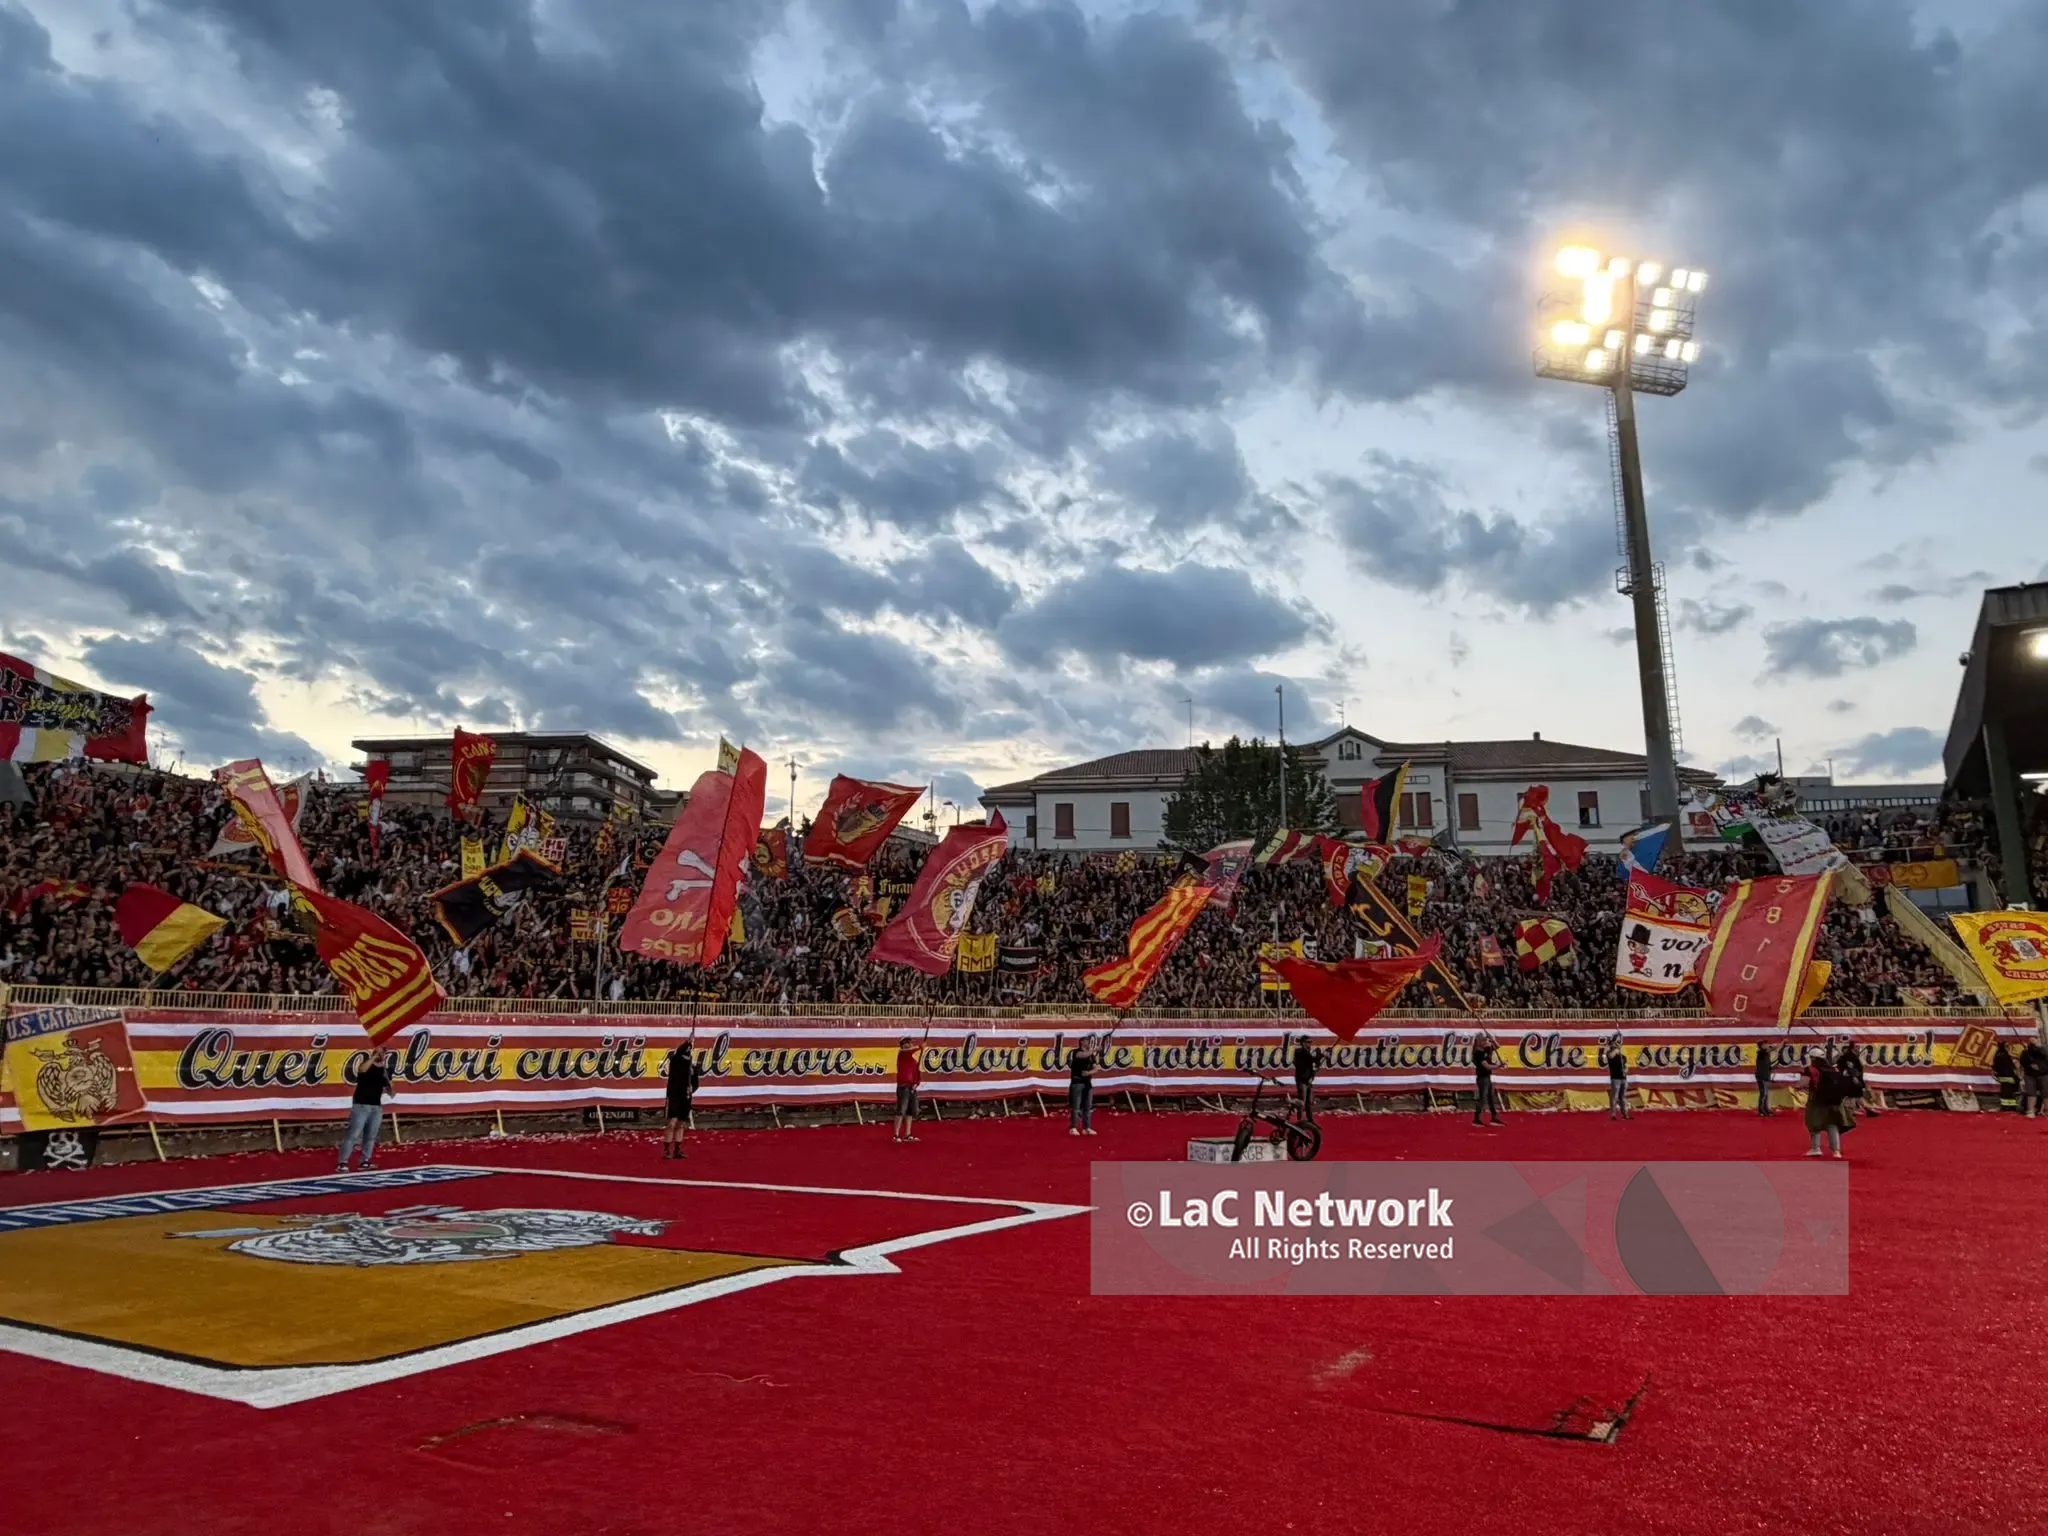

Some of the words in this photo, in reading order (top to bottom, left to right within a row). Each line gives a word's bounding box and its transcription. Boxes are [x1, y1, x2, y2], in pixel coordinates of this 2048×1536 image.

[960, 954, 993, 971] AMO
[6, 1013, 37, 1039] U.S.
[177, 1027, 329, 1091] Quei
[514, 1033, 648, 1081] cuciti
[742, 1046, 888, 1078] cuore...
[922, 1030, 1033, 1074] colori
[1040, 1031, 1136, 1073] dlle
[1144, 1036, 1226, 1073] notti
[1518, 1031, 1587, 1071] Che
[1636, 1037, 1747, 1080] sogno
